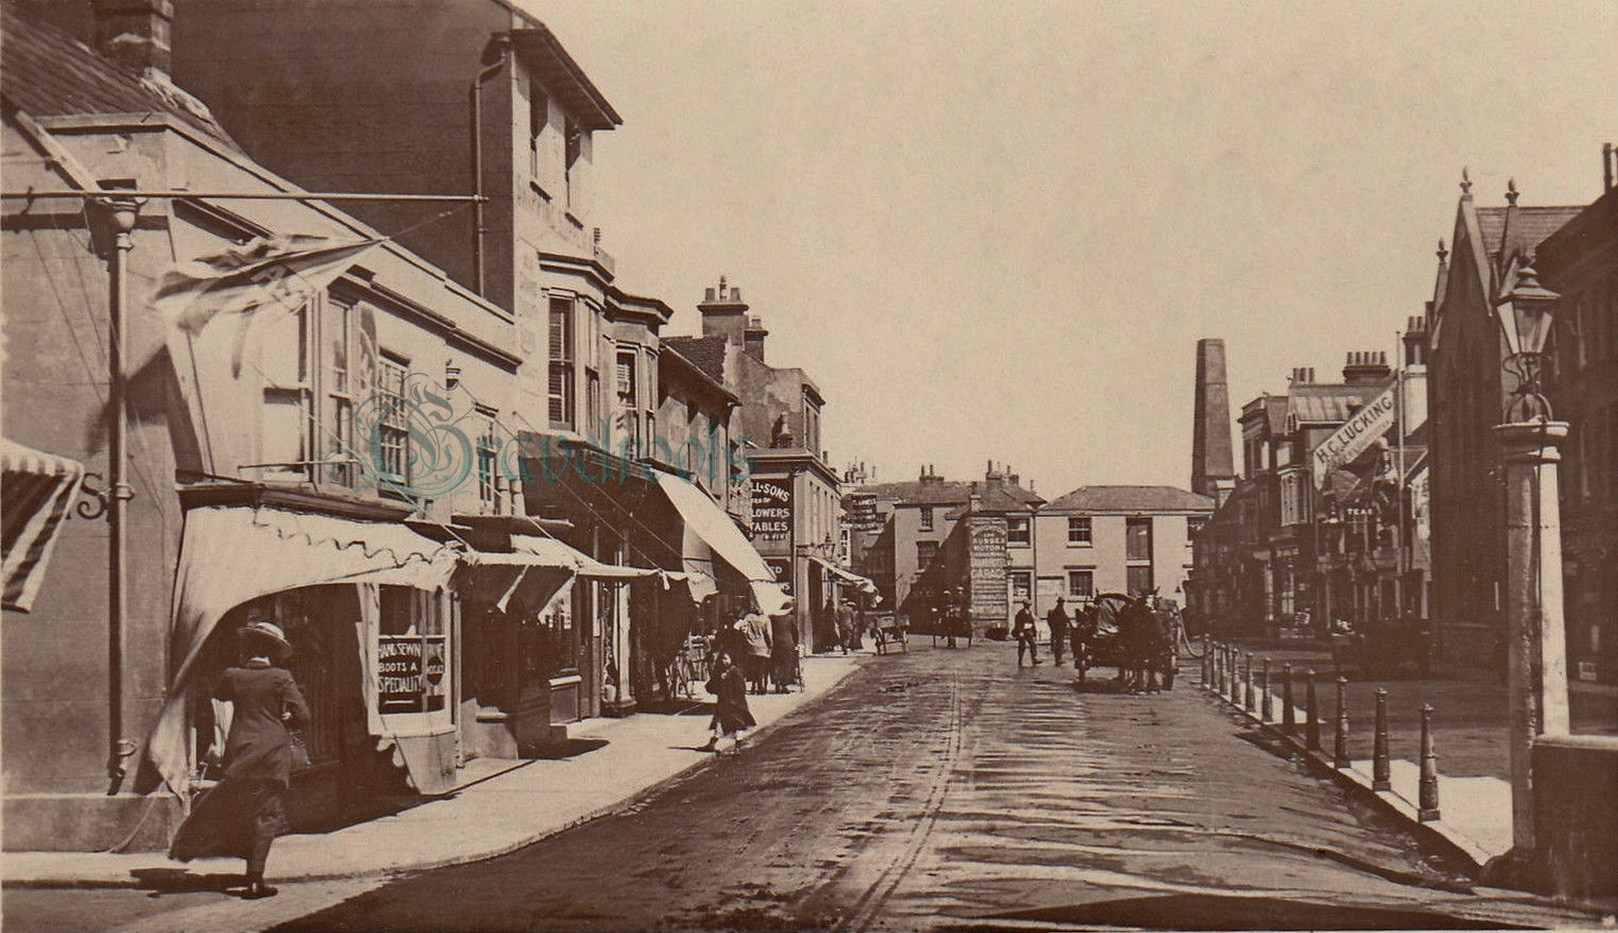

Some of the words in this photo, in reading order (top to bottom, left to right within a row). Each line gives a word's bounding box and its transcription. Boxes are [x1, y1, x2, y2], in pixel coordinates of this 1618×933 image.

[1337, 396, 1392, 446] LUCKING
[378, 662, 407, 673] BOOTS
[410, 662, 418, 671] A
